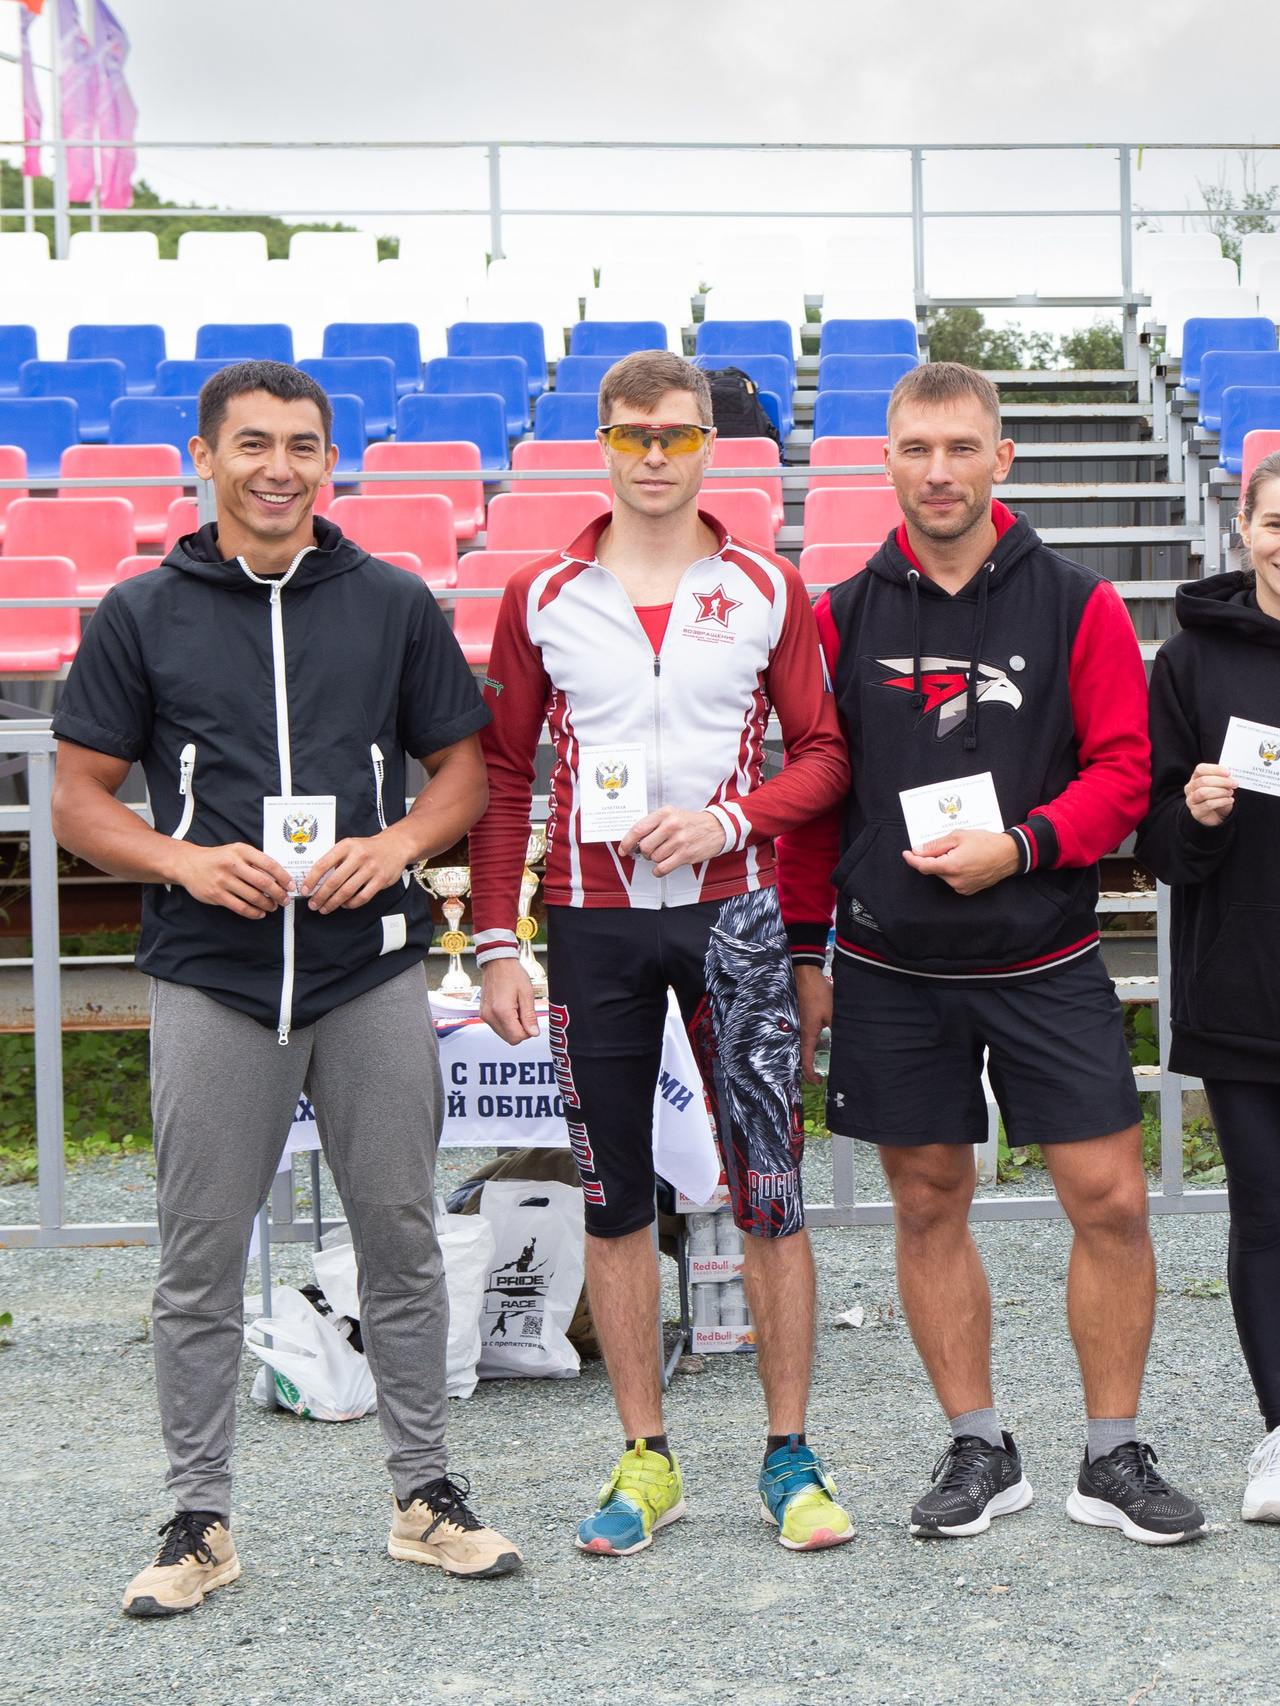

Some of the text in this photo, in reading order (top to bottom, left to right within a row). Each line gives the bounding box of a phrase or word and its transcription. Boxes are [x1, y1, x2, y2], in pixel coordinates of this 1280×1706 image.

[479, 1062, 556, 1085] ПРЕП
[693, 1260, 728, 1271] Red Bull
[496, 1275, 544, 1286] PRIDE
[501, 1300, 536, 1309] RACE
[697, 1331, 732, 1341] Red Bull
